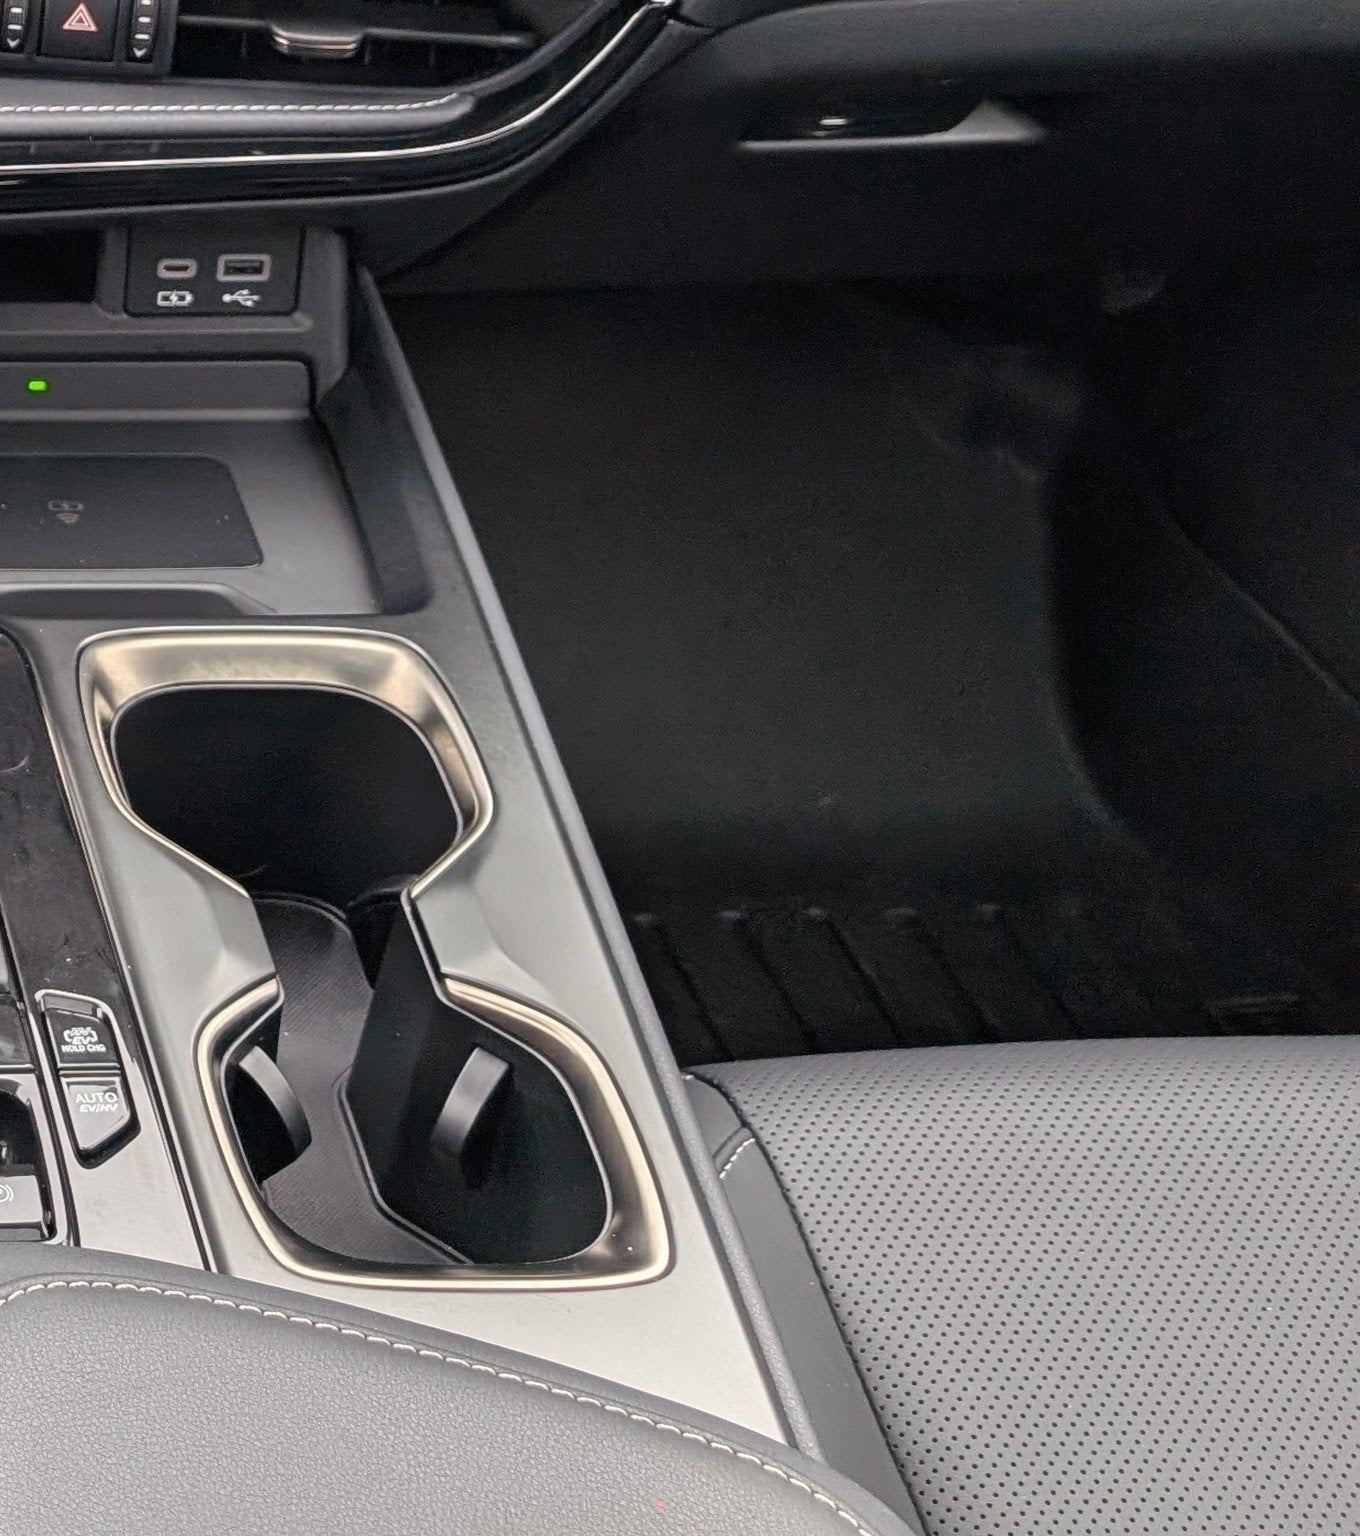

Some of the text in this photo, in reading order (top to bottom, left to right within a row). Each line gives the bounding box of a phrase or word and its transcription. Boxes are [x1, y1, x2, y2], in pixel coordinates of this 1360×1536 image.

[61, 1044, 85, 1052] HOLD
[76, 1092, 118, 1103] AUTO
[79, 1103, 119, 1113] EV/HV
